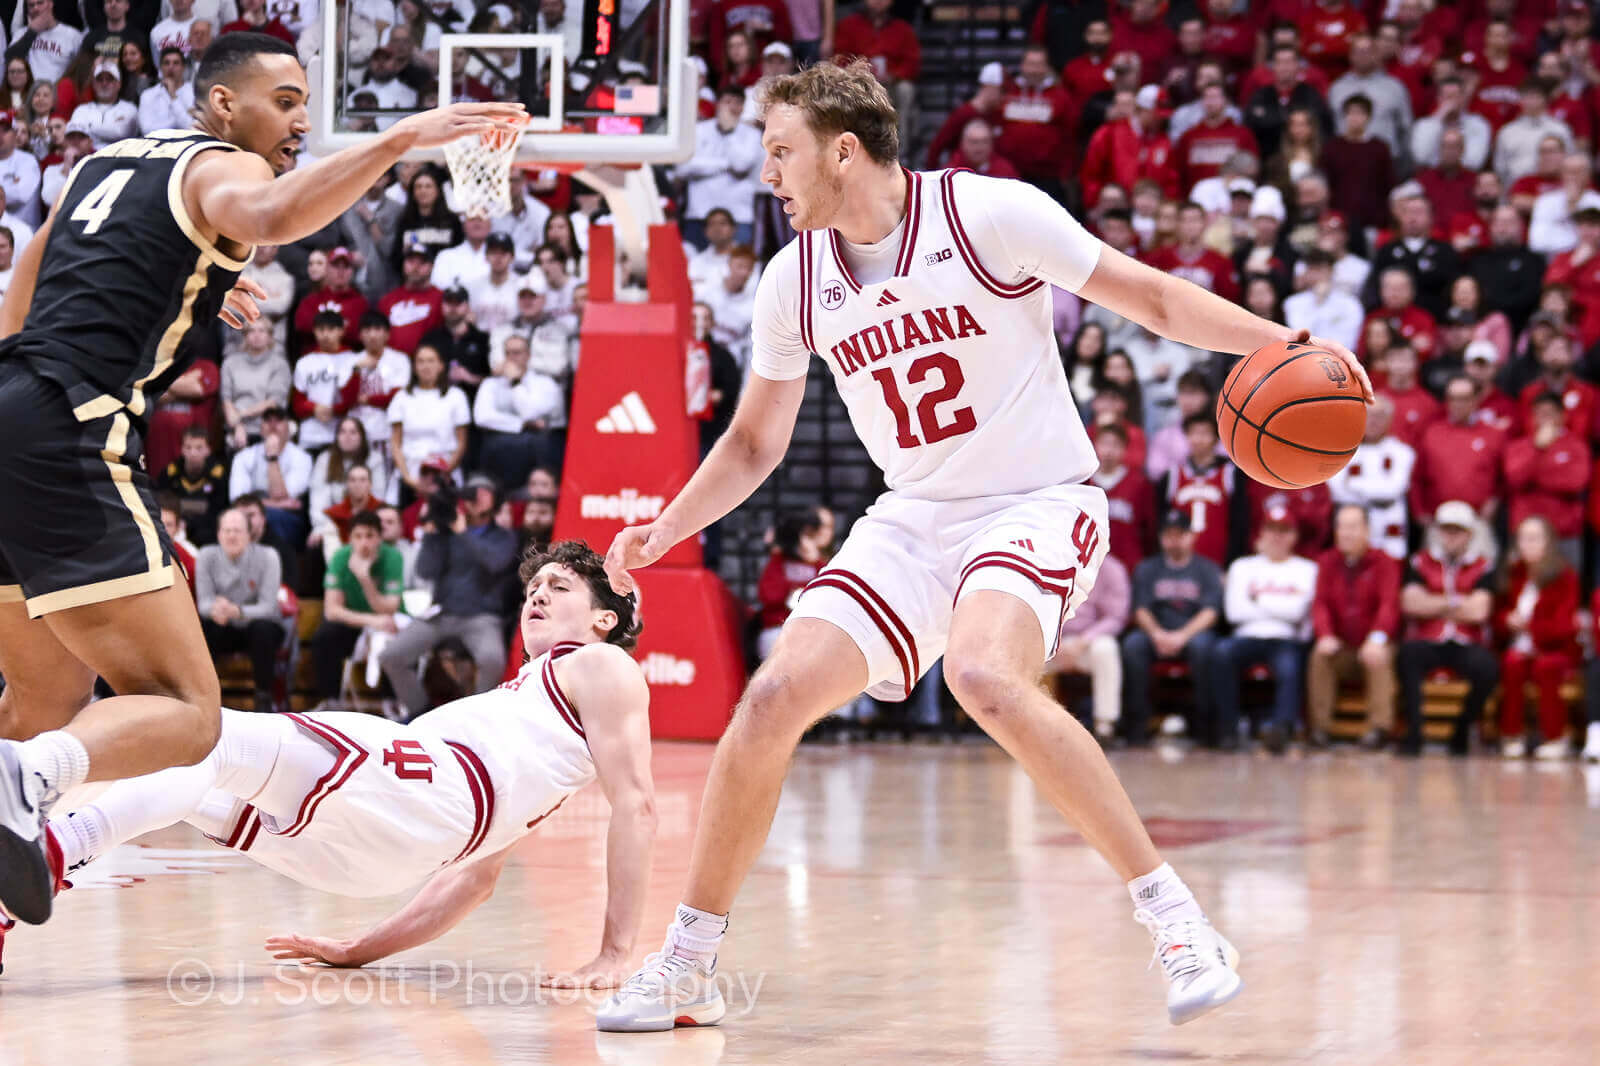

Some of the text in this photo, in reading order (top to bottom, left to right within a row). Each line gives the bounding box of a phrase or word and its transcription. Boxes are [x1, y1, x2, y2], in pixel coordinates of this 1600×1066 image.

[71, 169, 135, 234] 4
[824, 286, 842, 304] 76
[831, 305, 986, 377] INDIANA
[871, 352, 977, 448] 12
[581, 488, 665, 525] meijer
